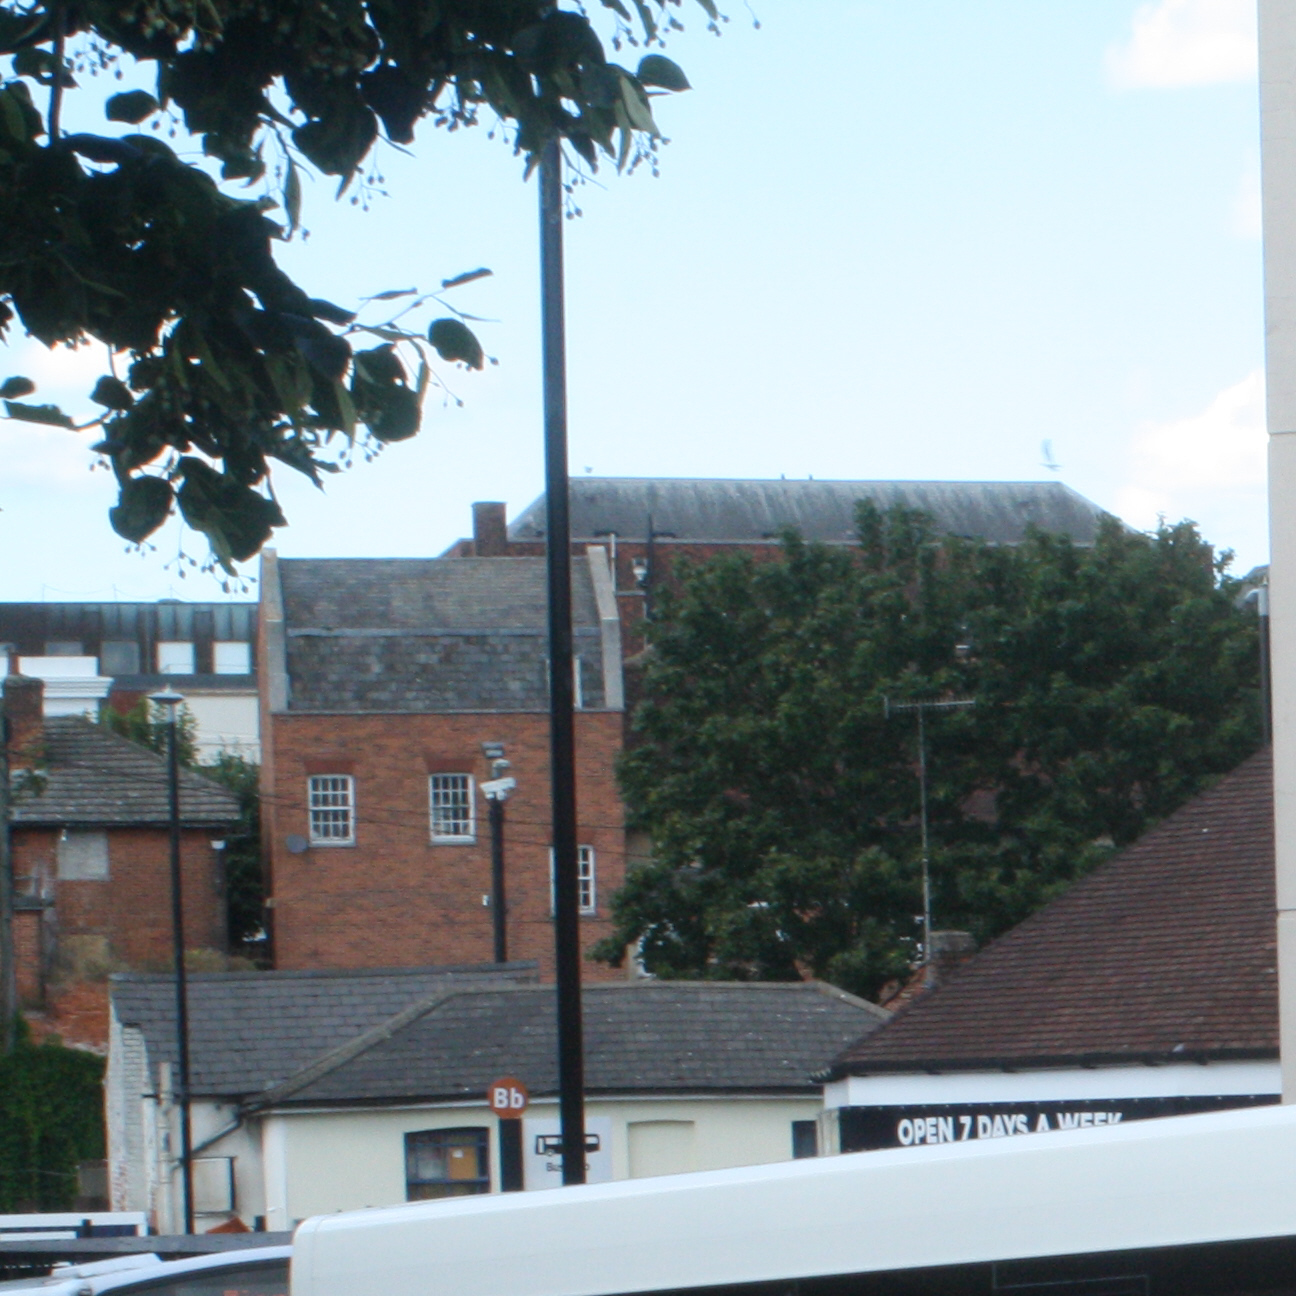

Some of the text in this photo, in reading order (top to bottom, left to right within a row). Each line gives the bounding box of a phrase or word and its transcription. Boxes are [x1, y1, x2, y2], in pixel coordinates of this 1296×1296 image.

[493, 1087, 524, 1109] Bb
[897, 1116, 954, 1146] OPEN
[959, 1115, 973, 1141] 7
[977, 1113, 1029, 1140] DAYS
[1034, 1113, 1051, 1132] A
